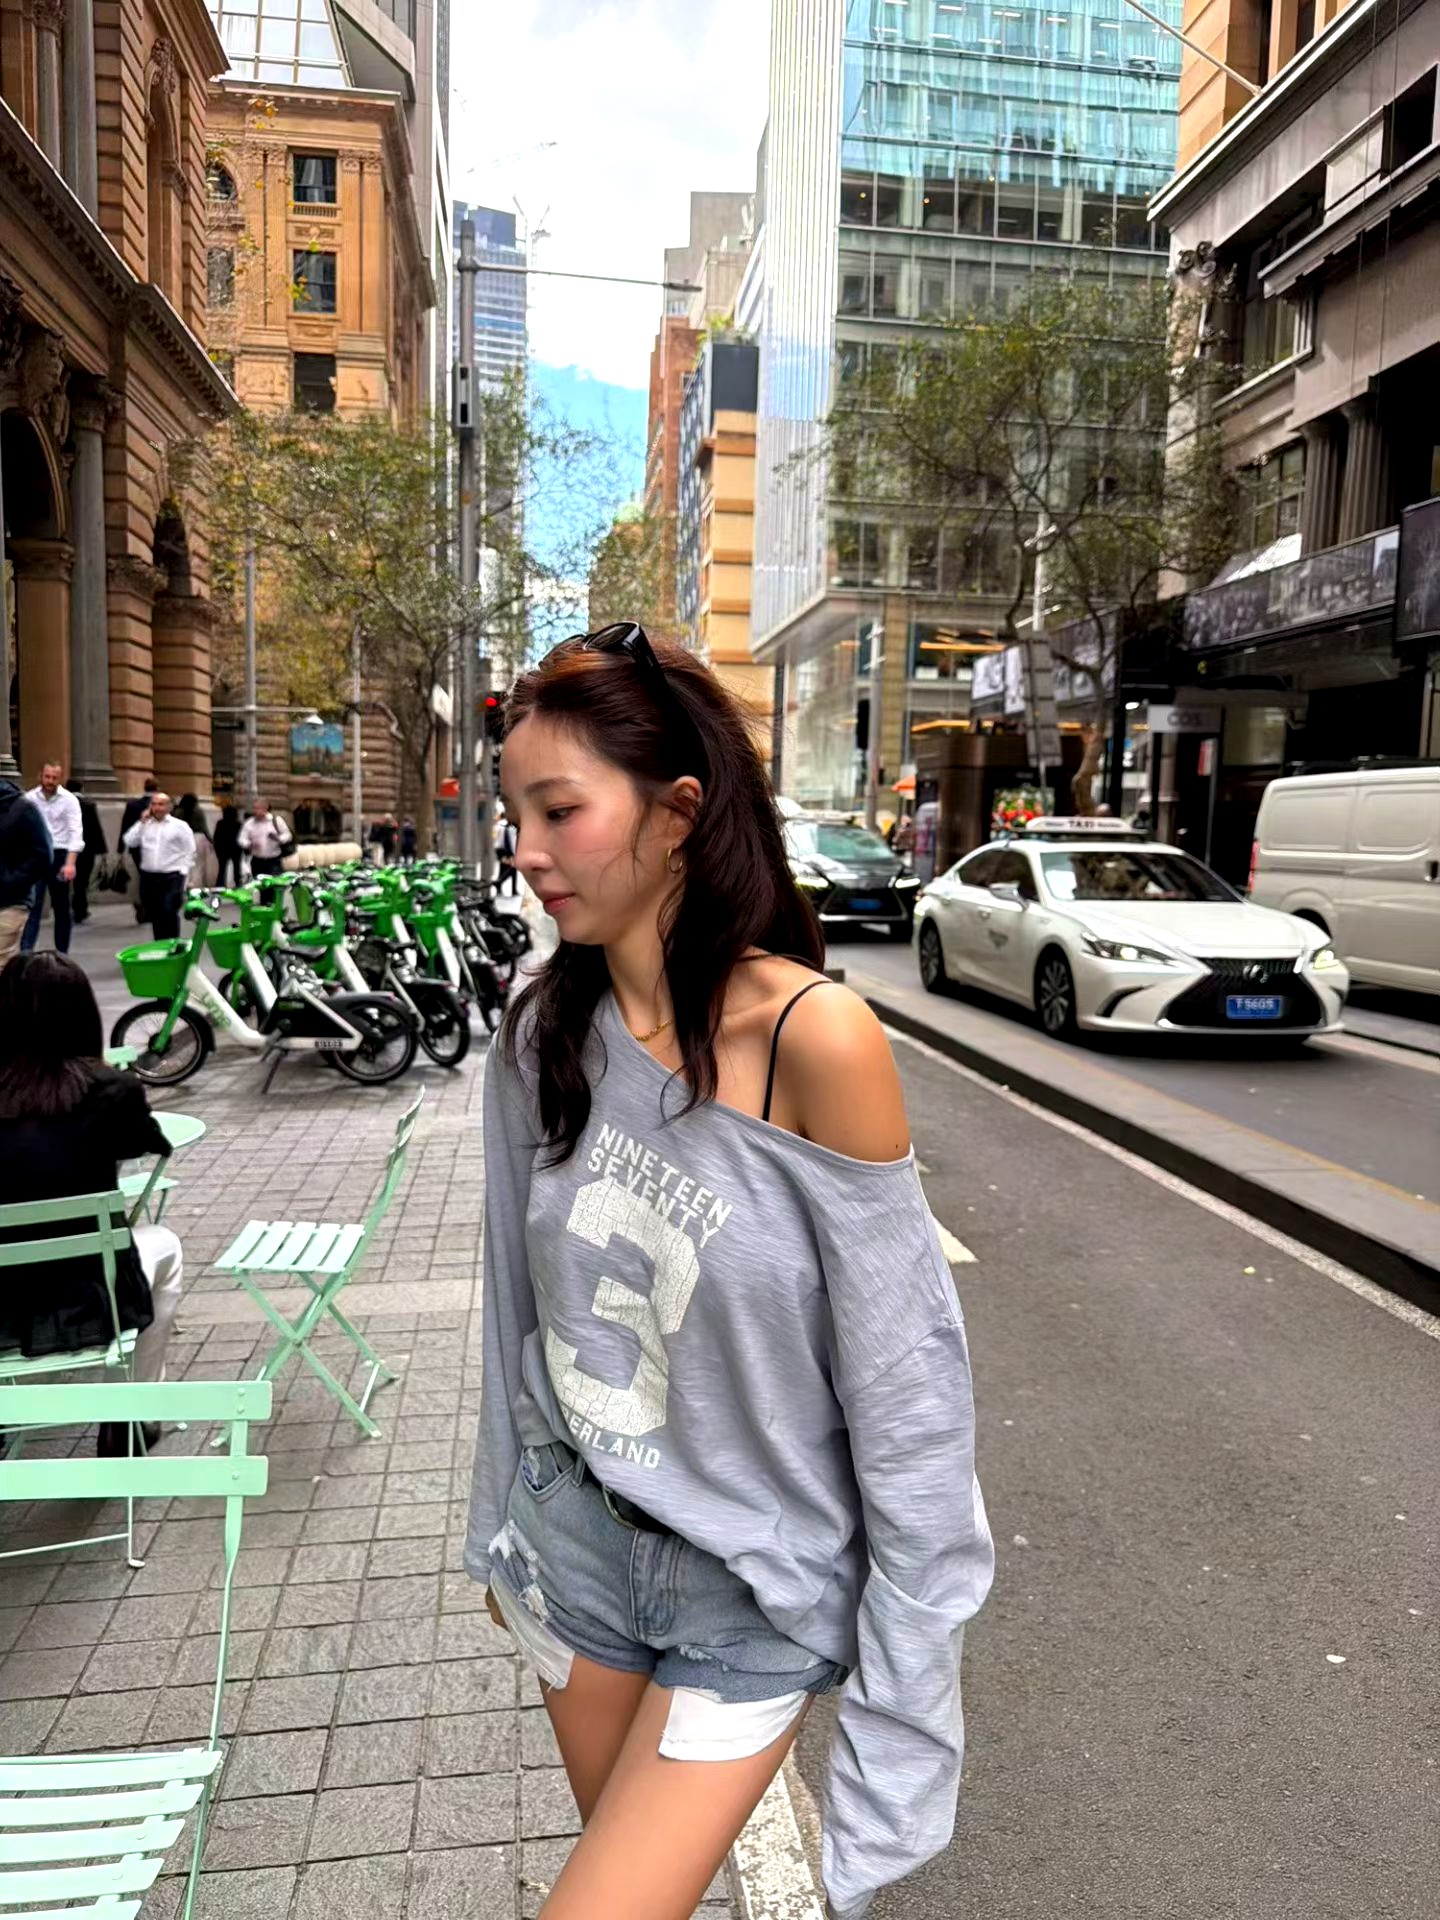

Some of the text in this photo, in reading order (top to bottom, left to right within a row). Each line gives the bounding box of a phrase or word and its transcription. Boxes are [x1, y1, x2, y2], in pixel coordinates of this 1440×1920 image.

[587, 1149, 719, 1248] SEVENTY
[597, 1123, 733, 1226] NINETEEN
[545, 1177, 700, 1436] 3
